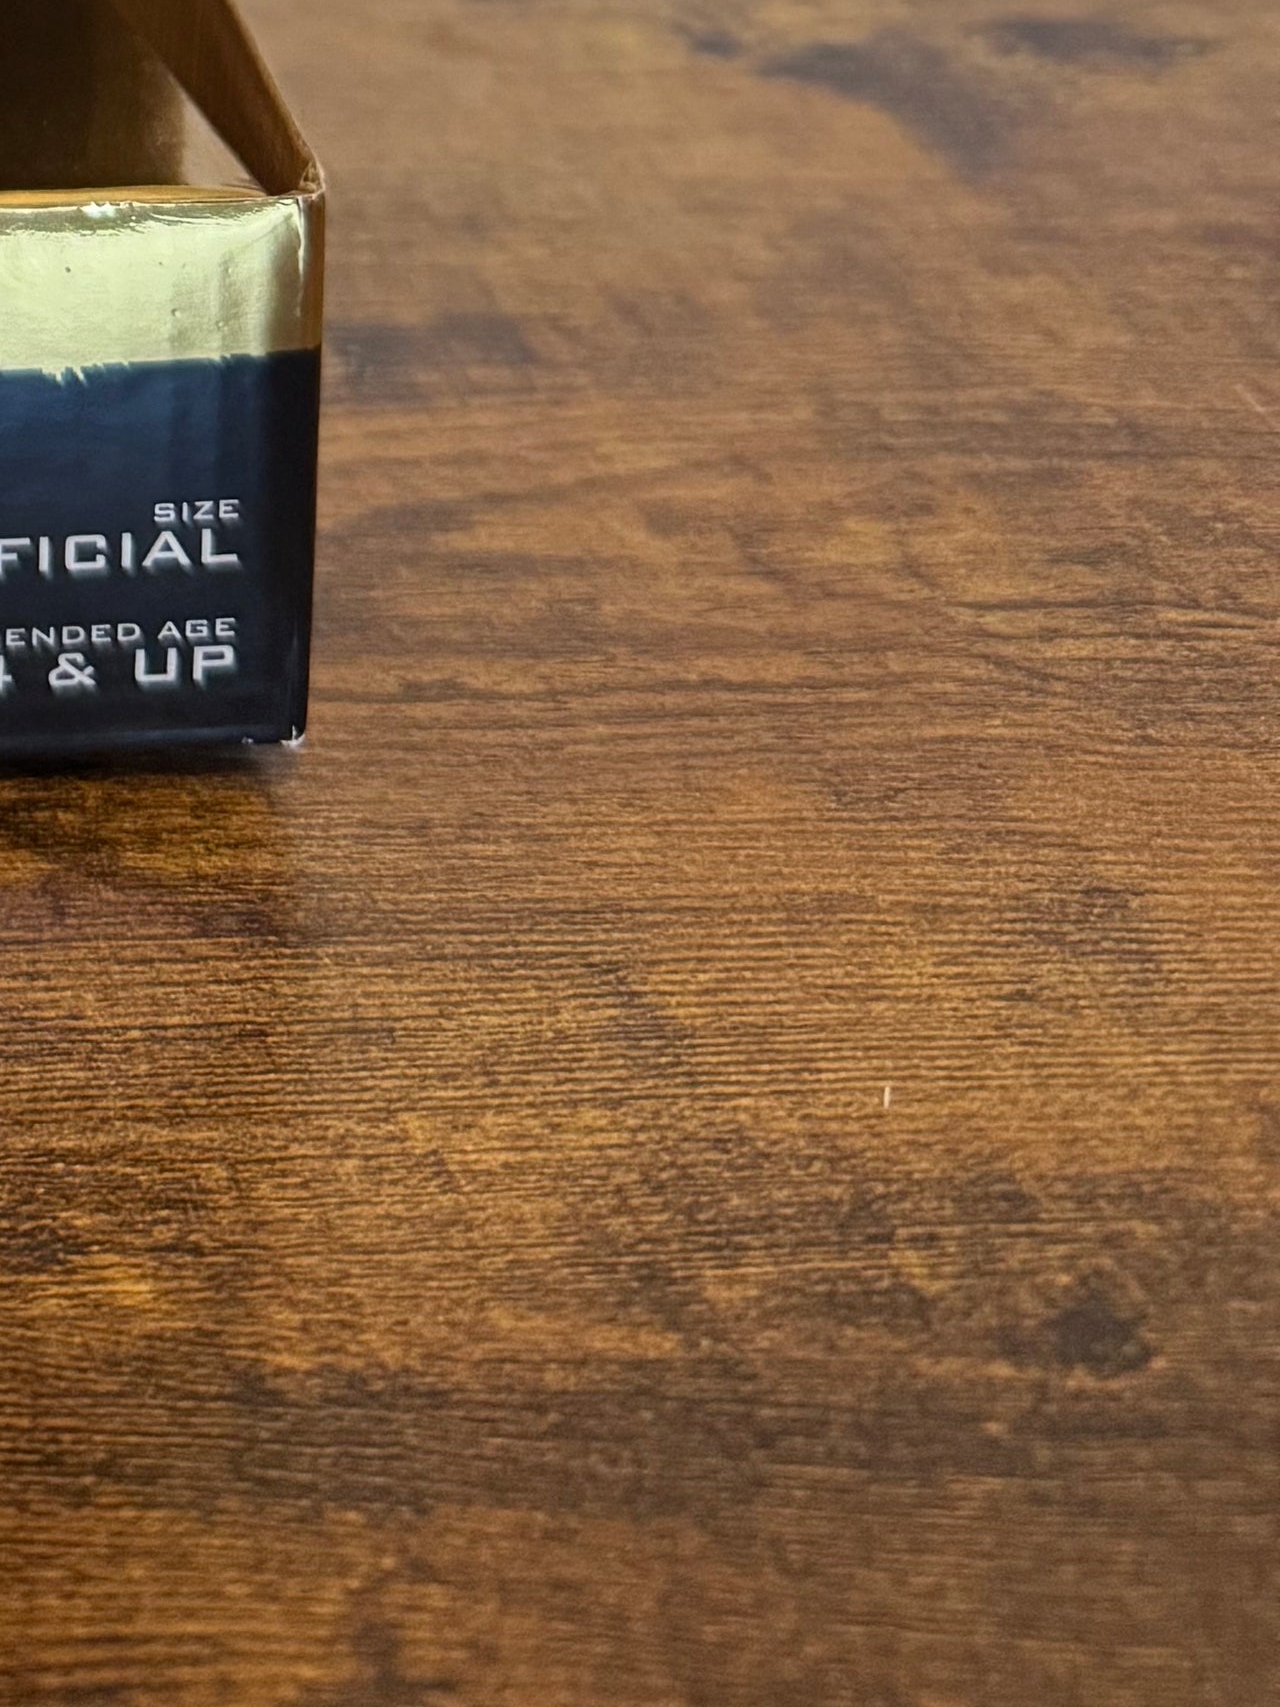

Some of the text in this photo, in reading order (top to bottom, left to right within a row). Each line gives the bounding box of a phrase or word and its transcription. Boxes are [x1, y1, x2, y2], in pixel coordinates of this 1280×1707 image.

[153, 498, 240, 523] SIZE
[157, 617, 237, 641] AGE
[47, 652, 98, 689] &
[133, 645, 236, 684] UP
